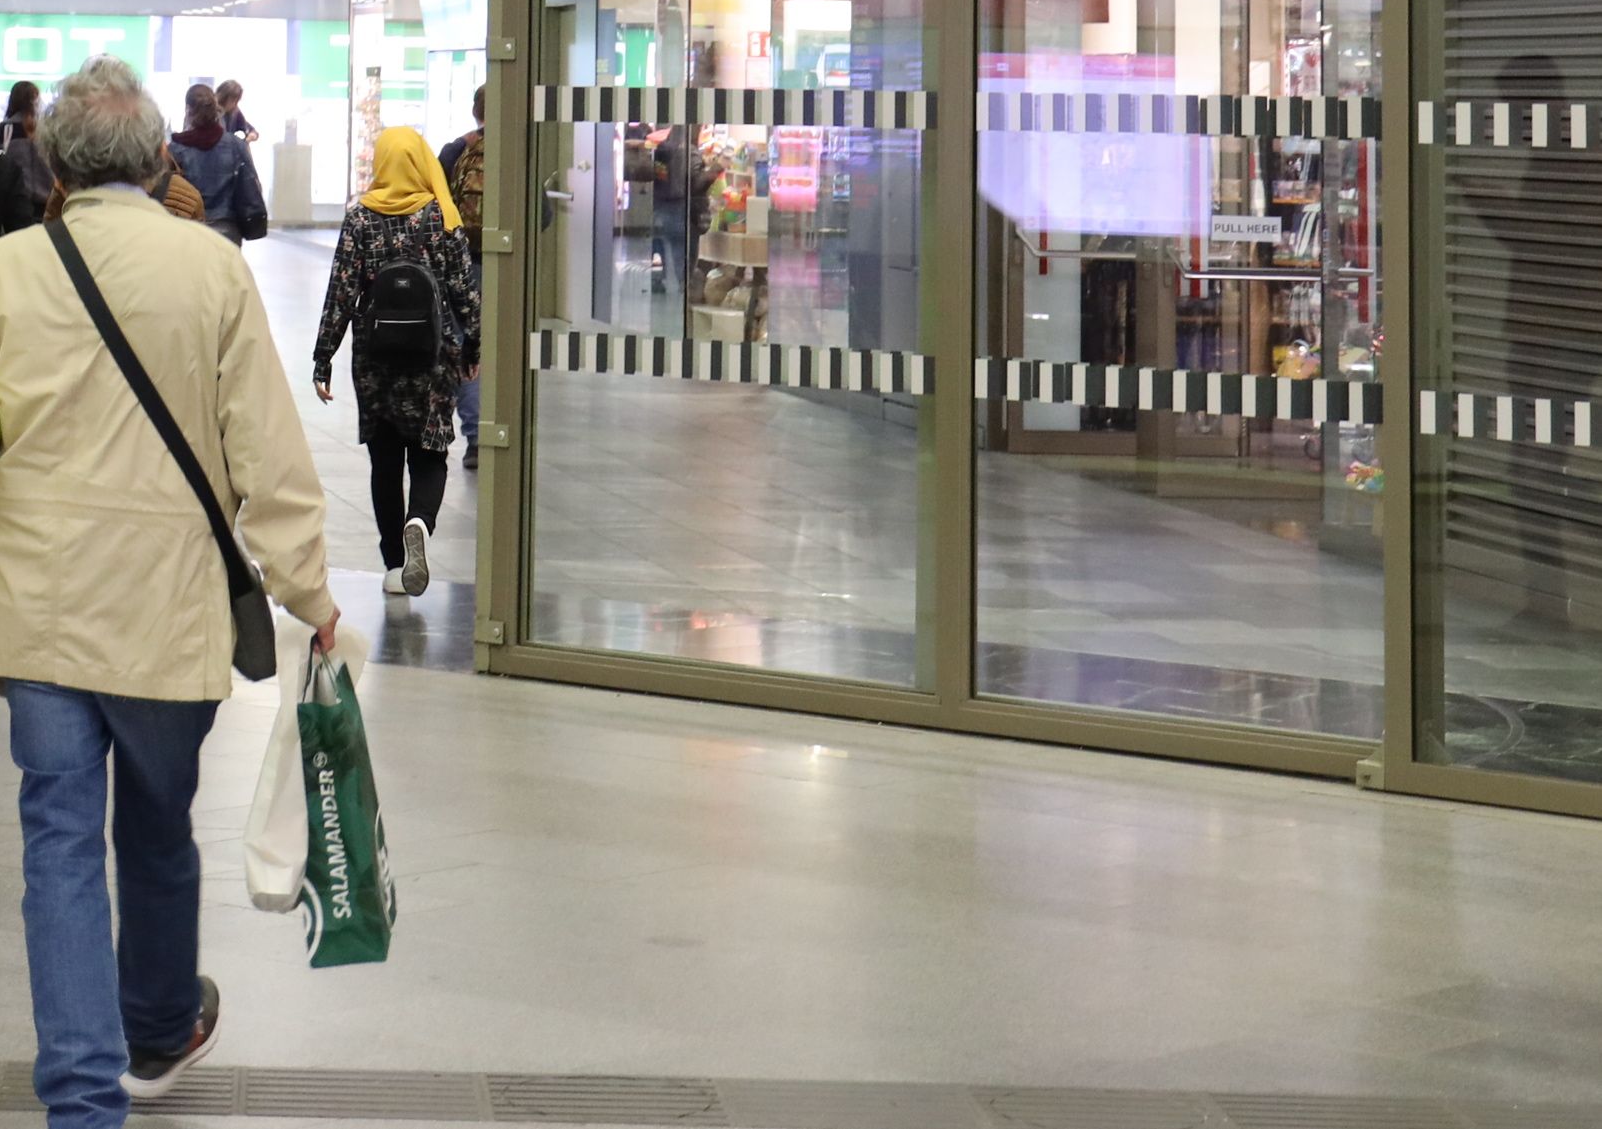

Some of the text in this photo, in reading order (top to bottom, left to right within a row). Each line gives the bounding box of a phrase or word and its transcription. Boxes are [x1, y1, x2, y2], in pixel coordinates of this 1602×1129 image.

[1214, 223, 1279, 234] PULL HERE
[318, 769, 352, 919] SALAMANDER
